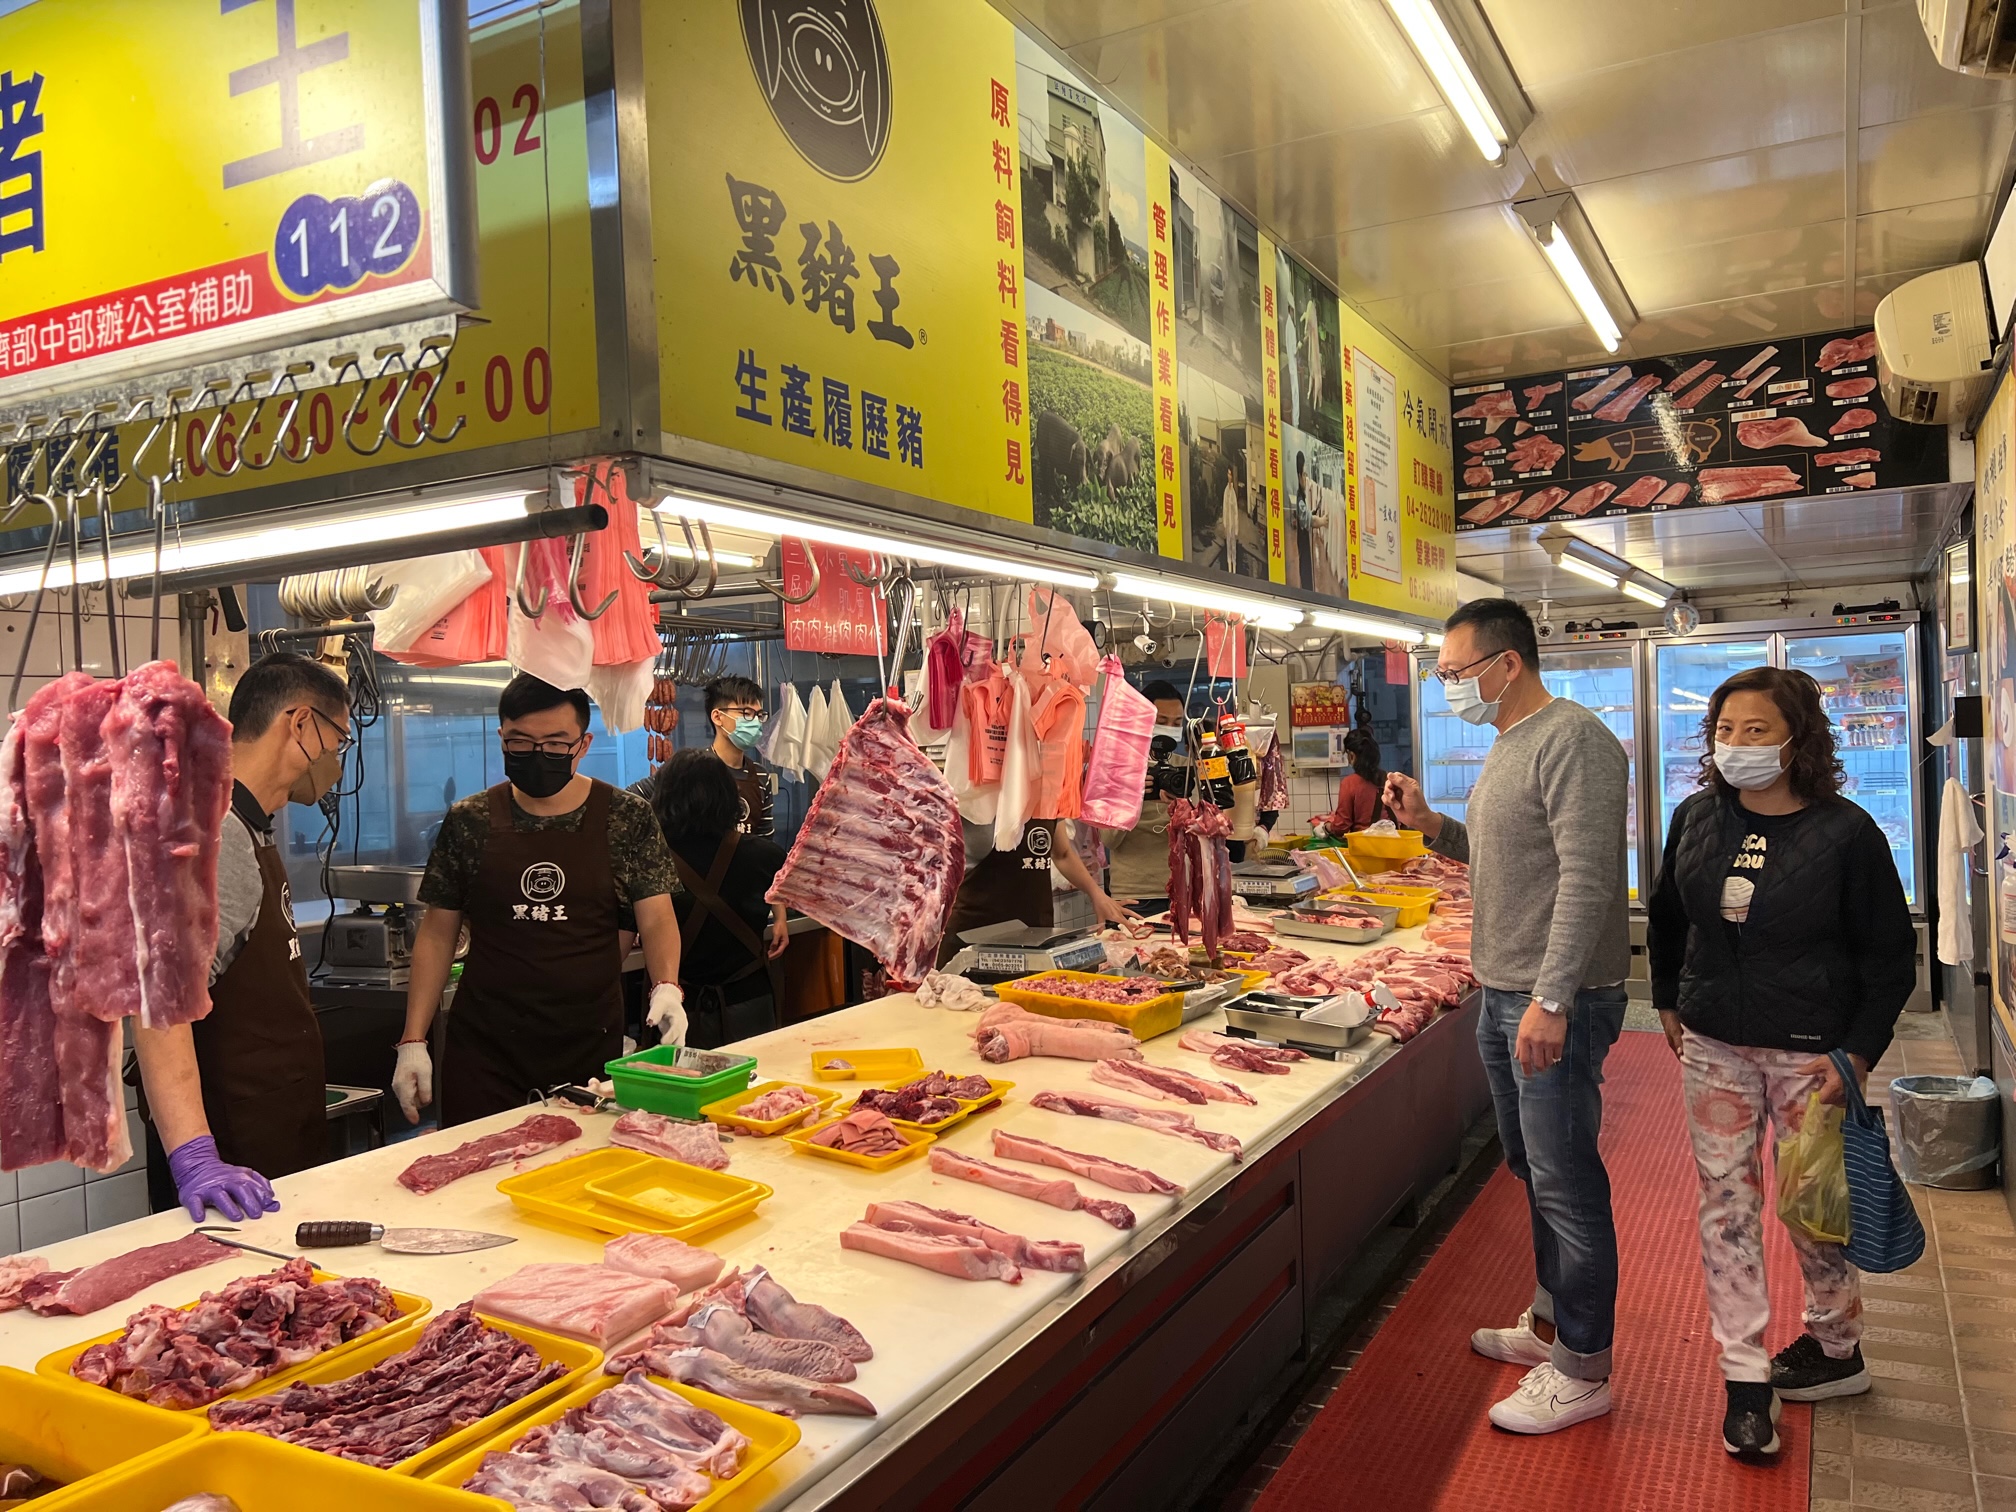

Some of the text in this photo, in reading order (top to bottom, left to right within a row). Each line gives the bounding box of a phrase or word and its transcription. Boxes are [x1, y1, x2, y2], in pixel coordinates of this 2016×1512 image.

[291, 195, 402, 277] 112
[725, 172, 915, 350] 黑豬王
[990, 77, 1025, 486] 原料飼料看得見
[734, 349, 923, 469] 生產履歷豬
[1152, 200, 1177, 529] 管理作業看得見
[1264, 285, 1281, 558] 屠體衛生看得見
[1403, 389, 1450, 450] 冷氣開放
[1344, 345, 1358, 579] 無藥殘留看得見
[1407, 495, 1452, 534] 04-26228102
[512, 904, 568, 921] 黑豬王
